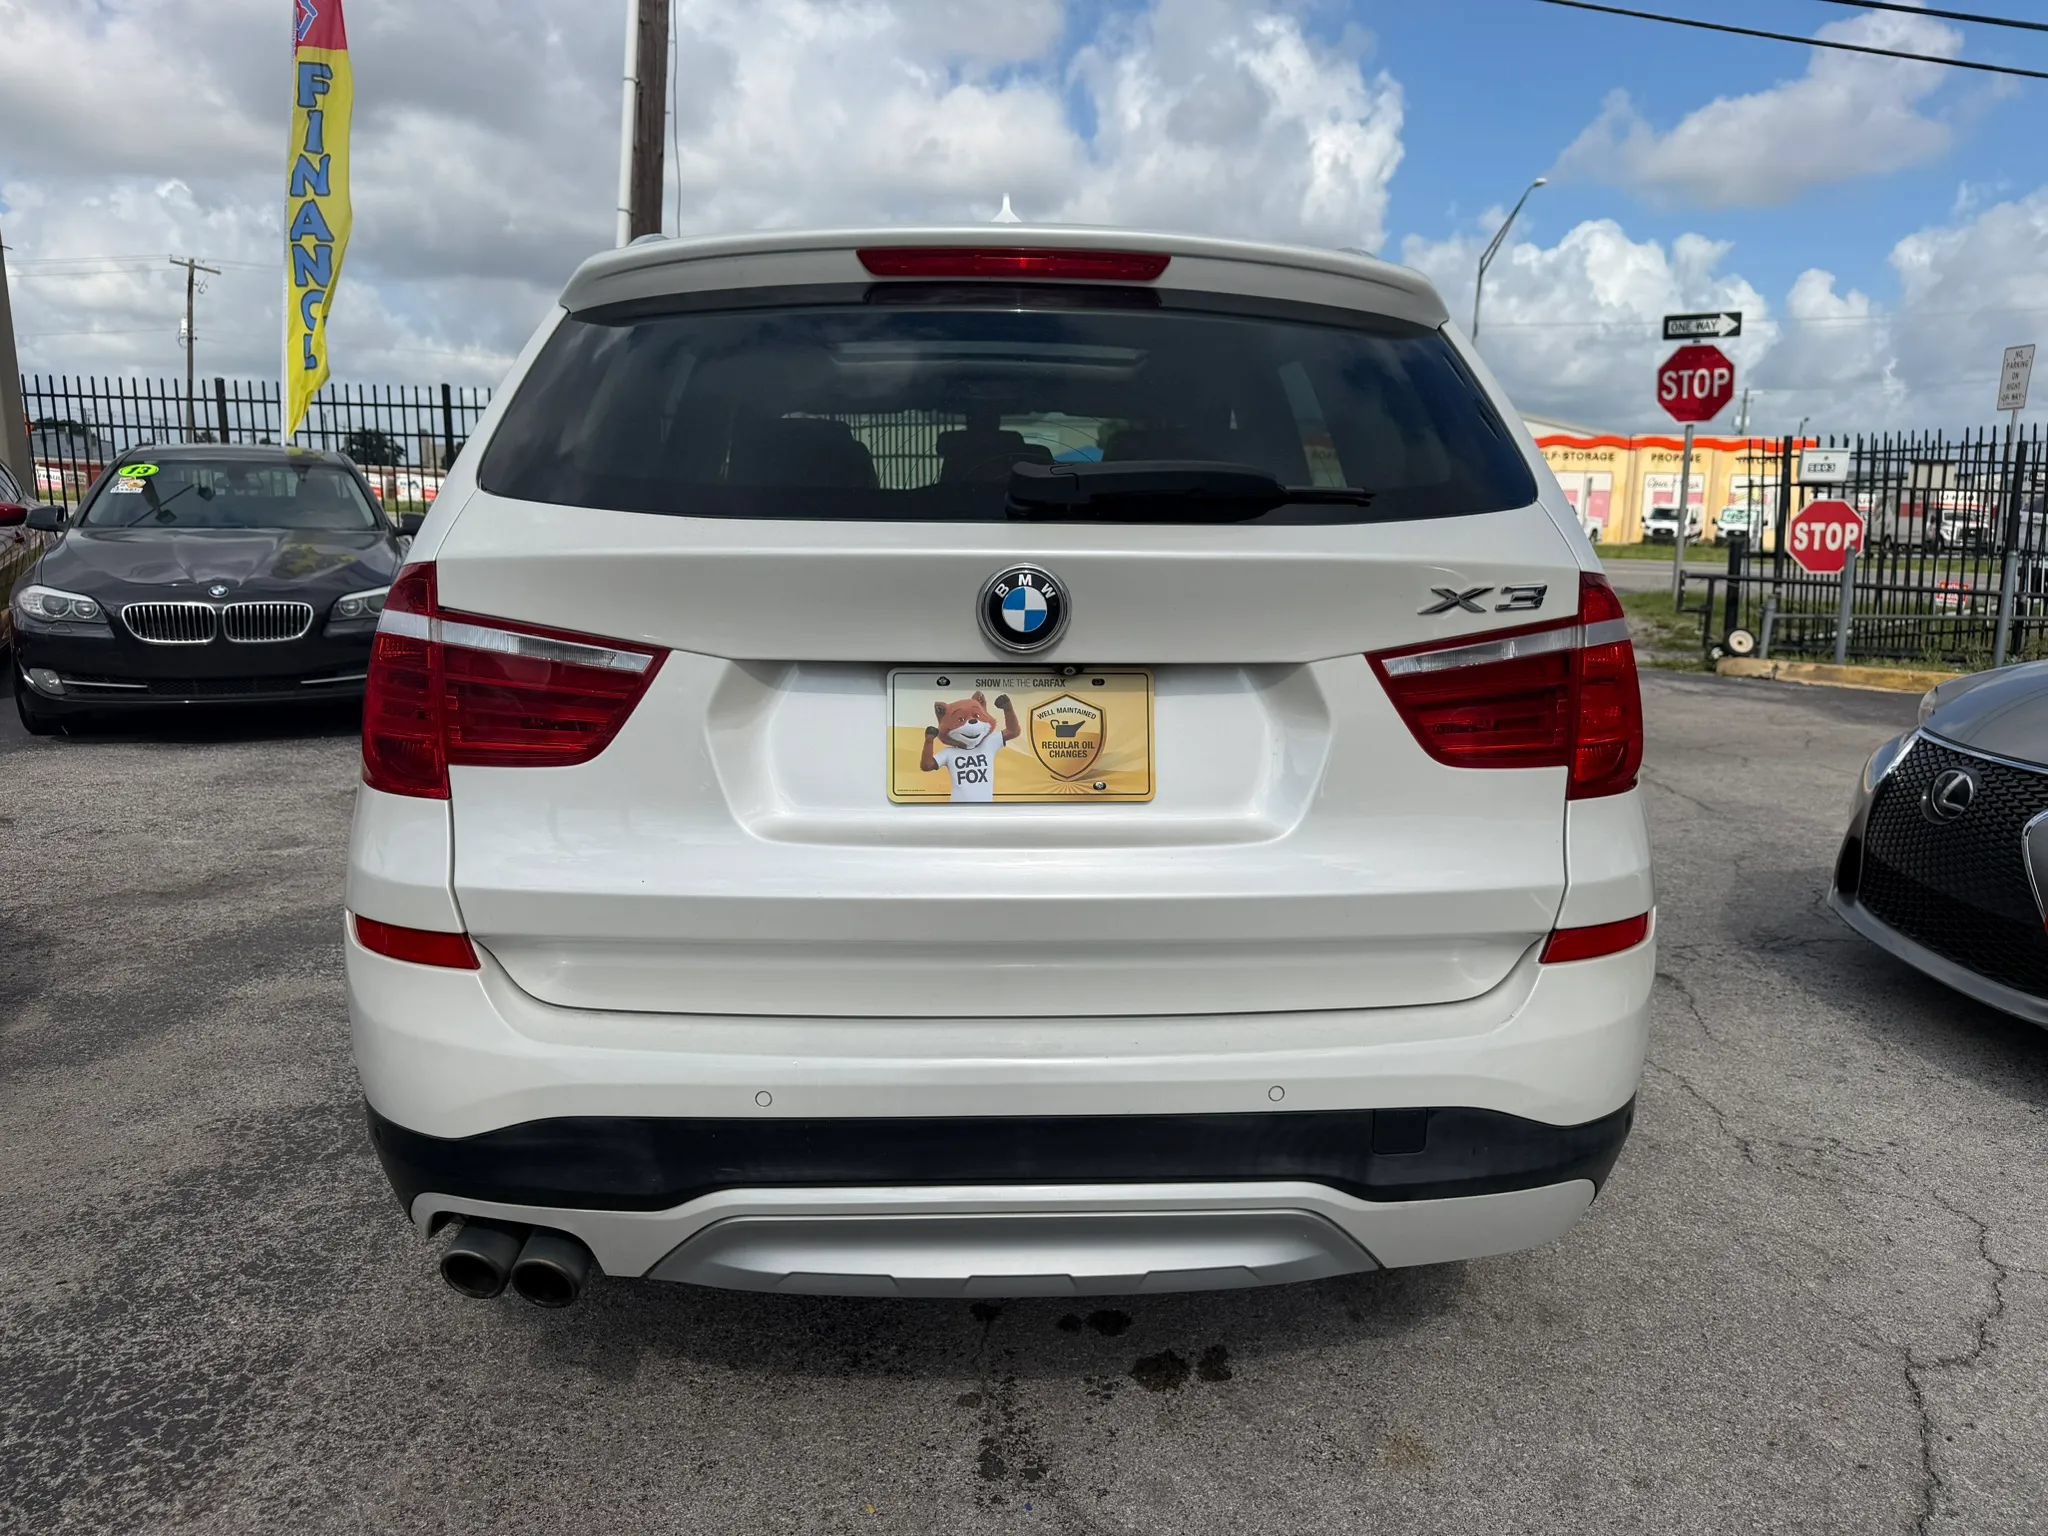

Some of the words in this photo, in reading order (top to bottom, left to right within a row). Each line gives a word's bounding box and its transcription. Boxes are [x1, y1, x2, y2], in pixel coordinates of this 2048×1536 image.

[1671, 321, 1691, 332] ONE
[1696, 320, 1717, 331] WAY
[1661, 368, 1730, 401] STOP
[1542, 451, 1617, 462] LF-STORAGE
[1793, 522, 1859, 551] STOP
[994, 574, 1056, 599] BMW
[1417, 584, 1548, 615] X3
[976, 679, 1000, 688] SHOW
[1002, 679, 1015, 688] ME
[1016, 679, 1031, 688] THE
[1032, 679, 1066, 688] CARFAX
[1037, 709, 1055, 720] WELL
[1056, 707, 1097, 720] MAINTAINED
[1041, 741, 1080, 749] REGULAR
[1081, 741, 1096, 749] OIL
[1049, 750, 1088, 758] CHANGES
[954, 754, 988, 770] CAR
[957, 769, 988, 785] FOX
